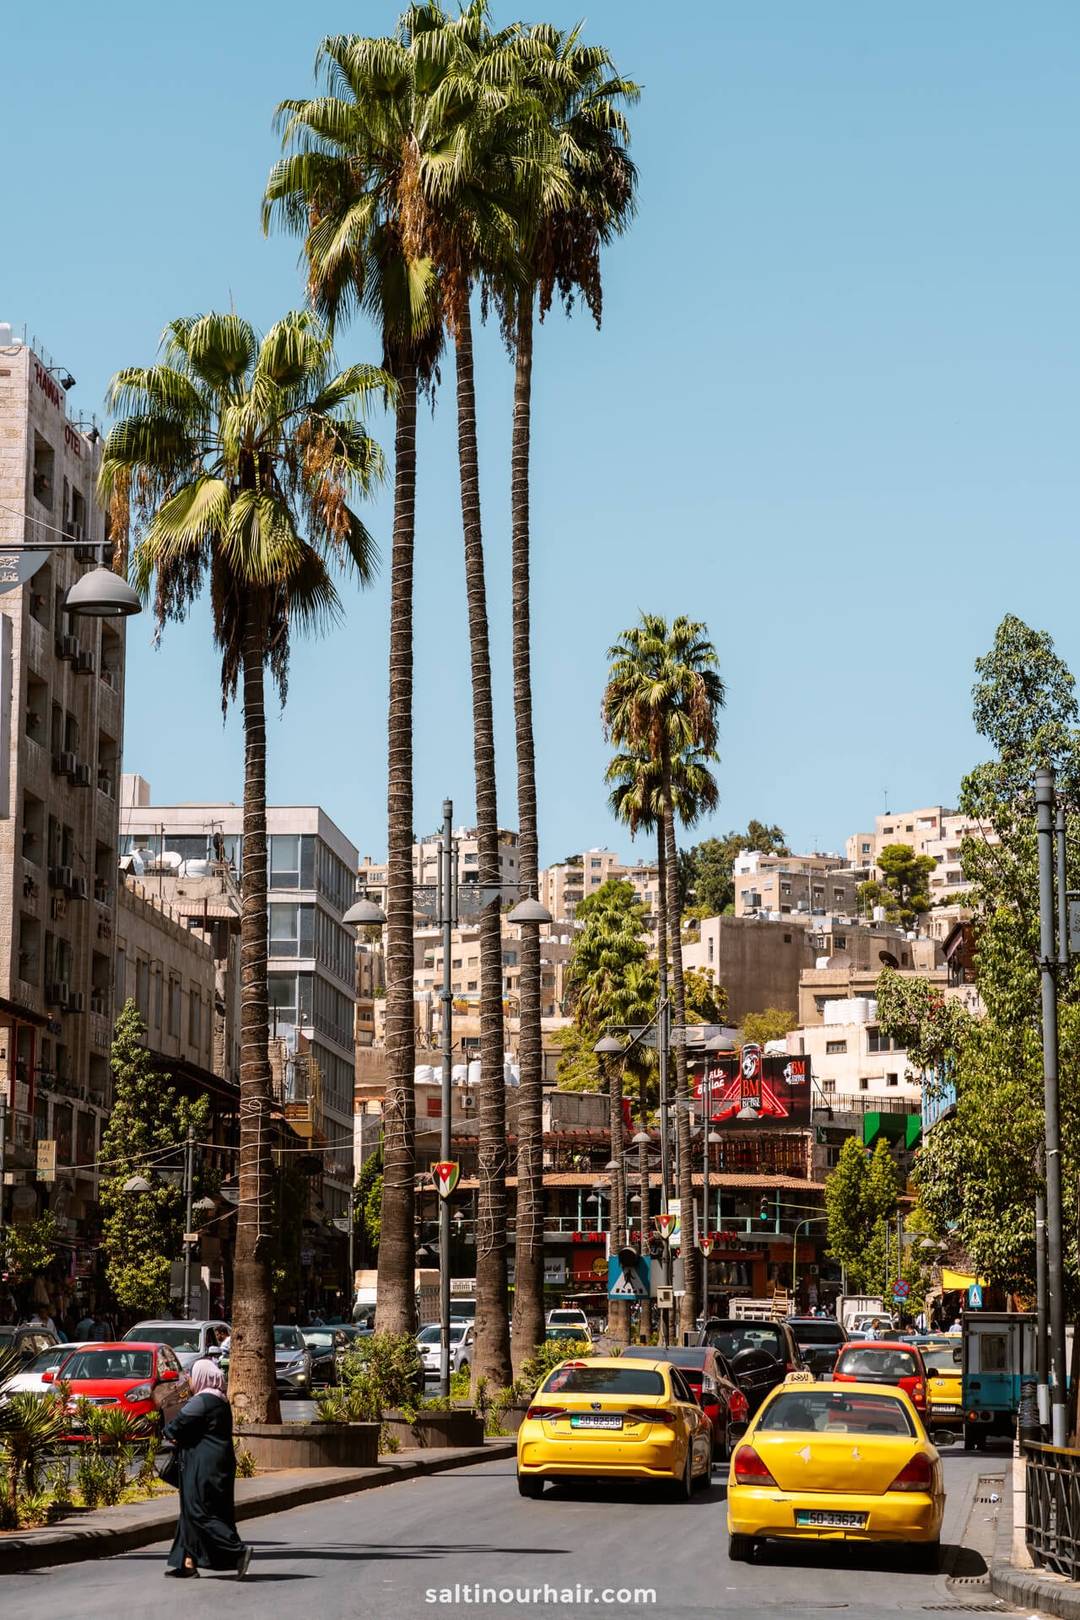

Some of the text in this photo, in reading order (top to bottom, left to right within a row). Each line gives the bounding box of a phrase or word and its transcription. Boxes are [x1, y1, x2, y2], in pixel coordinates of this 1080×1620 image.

[791, 1061, 805, 1074] BM
[743, 1079, 760, 1096] BM
[810, 1512, 863, 1527] 50-33624
